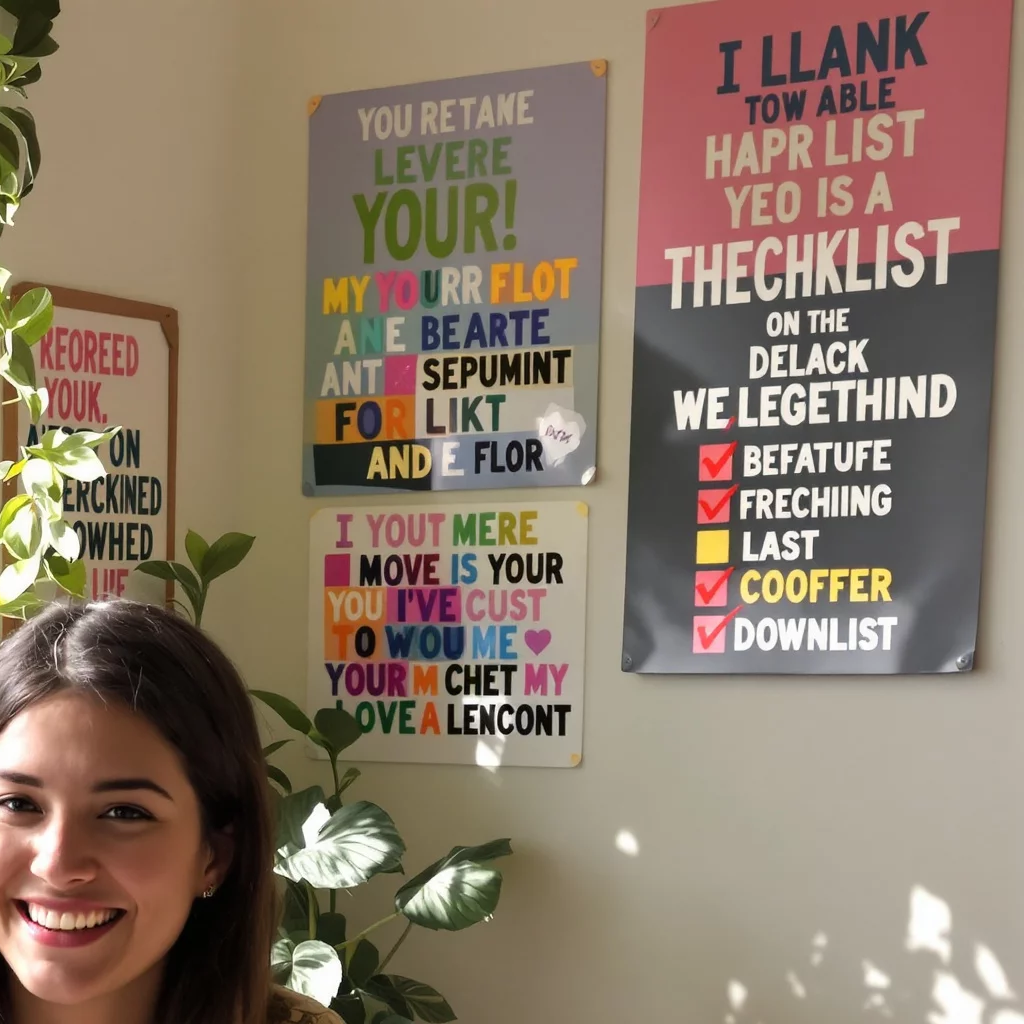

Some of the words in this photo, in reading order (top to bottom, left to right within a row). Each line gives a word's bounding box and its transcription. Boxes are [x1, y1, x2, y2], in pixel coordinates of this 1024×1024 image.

[716, 40, 742, 95] I
[762, 12, 930, 87] LLANK
[745, 89, 806, 125] TOW
[816, 77, 896, 117] ABLE
[358, 104, 412, 141] YOU
[374, 136, 512, 186] LEVERE
[705, 124, 813, 180] HAPR
[825, 109, 925, 167] LIST
[724, 181, 801, 229] YEO
[817, 175, 853, 218] IS
[864, 171, 893, 215] A
[353, 179, 517, 263] YOUR!
[664, 217, 960, 309] THECHKLIST
[322, 275, 371, 315] MY
[490, 258, 578, 304] FLOT
[334, 316, 406, 355] ANE
[421, 309, 550, 351] BEARTE
[766, 310, 799, 337] ON
[807, 308, 850, 333] THE
[321, 359, 382, 396] ANT
[422, 350, 571, 391] SEPUMINT
[749, 339, 869, 379] DELACK
[335, 401, 407, 441] FOR
[426, 395, 506, 434] LIKT
[674, 387, 729, 431] WE
[738, 374, 957, 428] LEGETHIND
[367, 445, 432, 479] AND
[474, 439, 544, 474] FLOR
[743, 439, 892, 477] BEFATUFE
[67, 520, 153, 561] OWHED
[336, 514, 353, 548] I
[366, 513, 445, 548] YOUT
[453, 511, 538, 546] MERE
[742, 530, 819, 562] LAST
[360, 554, 440, 586] MOVE
[451, 554, 478, 584] IS
[488, 552, 564, 585] YOUR
[740, 568, 892, 604] COOFFER
[328, 591, 383, 622] YOU
[397, 588, 457, 622] I'VE
[466, 588, 547, 622] CUST
[332, 626, 376, 659] TO
[472, 626, 517, 659] ME
[734, 617, 897, 652] DOWNLIST
[324, 663, 406, 697] YOUR
[413, 666, 438, 696] M
[445, 664, 517, 696] CHET
[524, 663, 569, 697] MY
[336, 700, 416, 736] OVE
[420, 702, 441, 735] A
[448, 704, 571, 736] LENCONT
